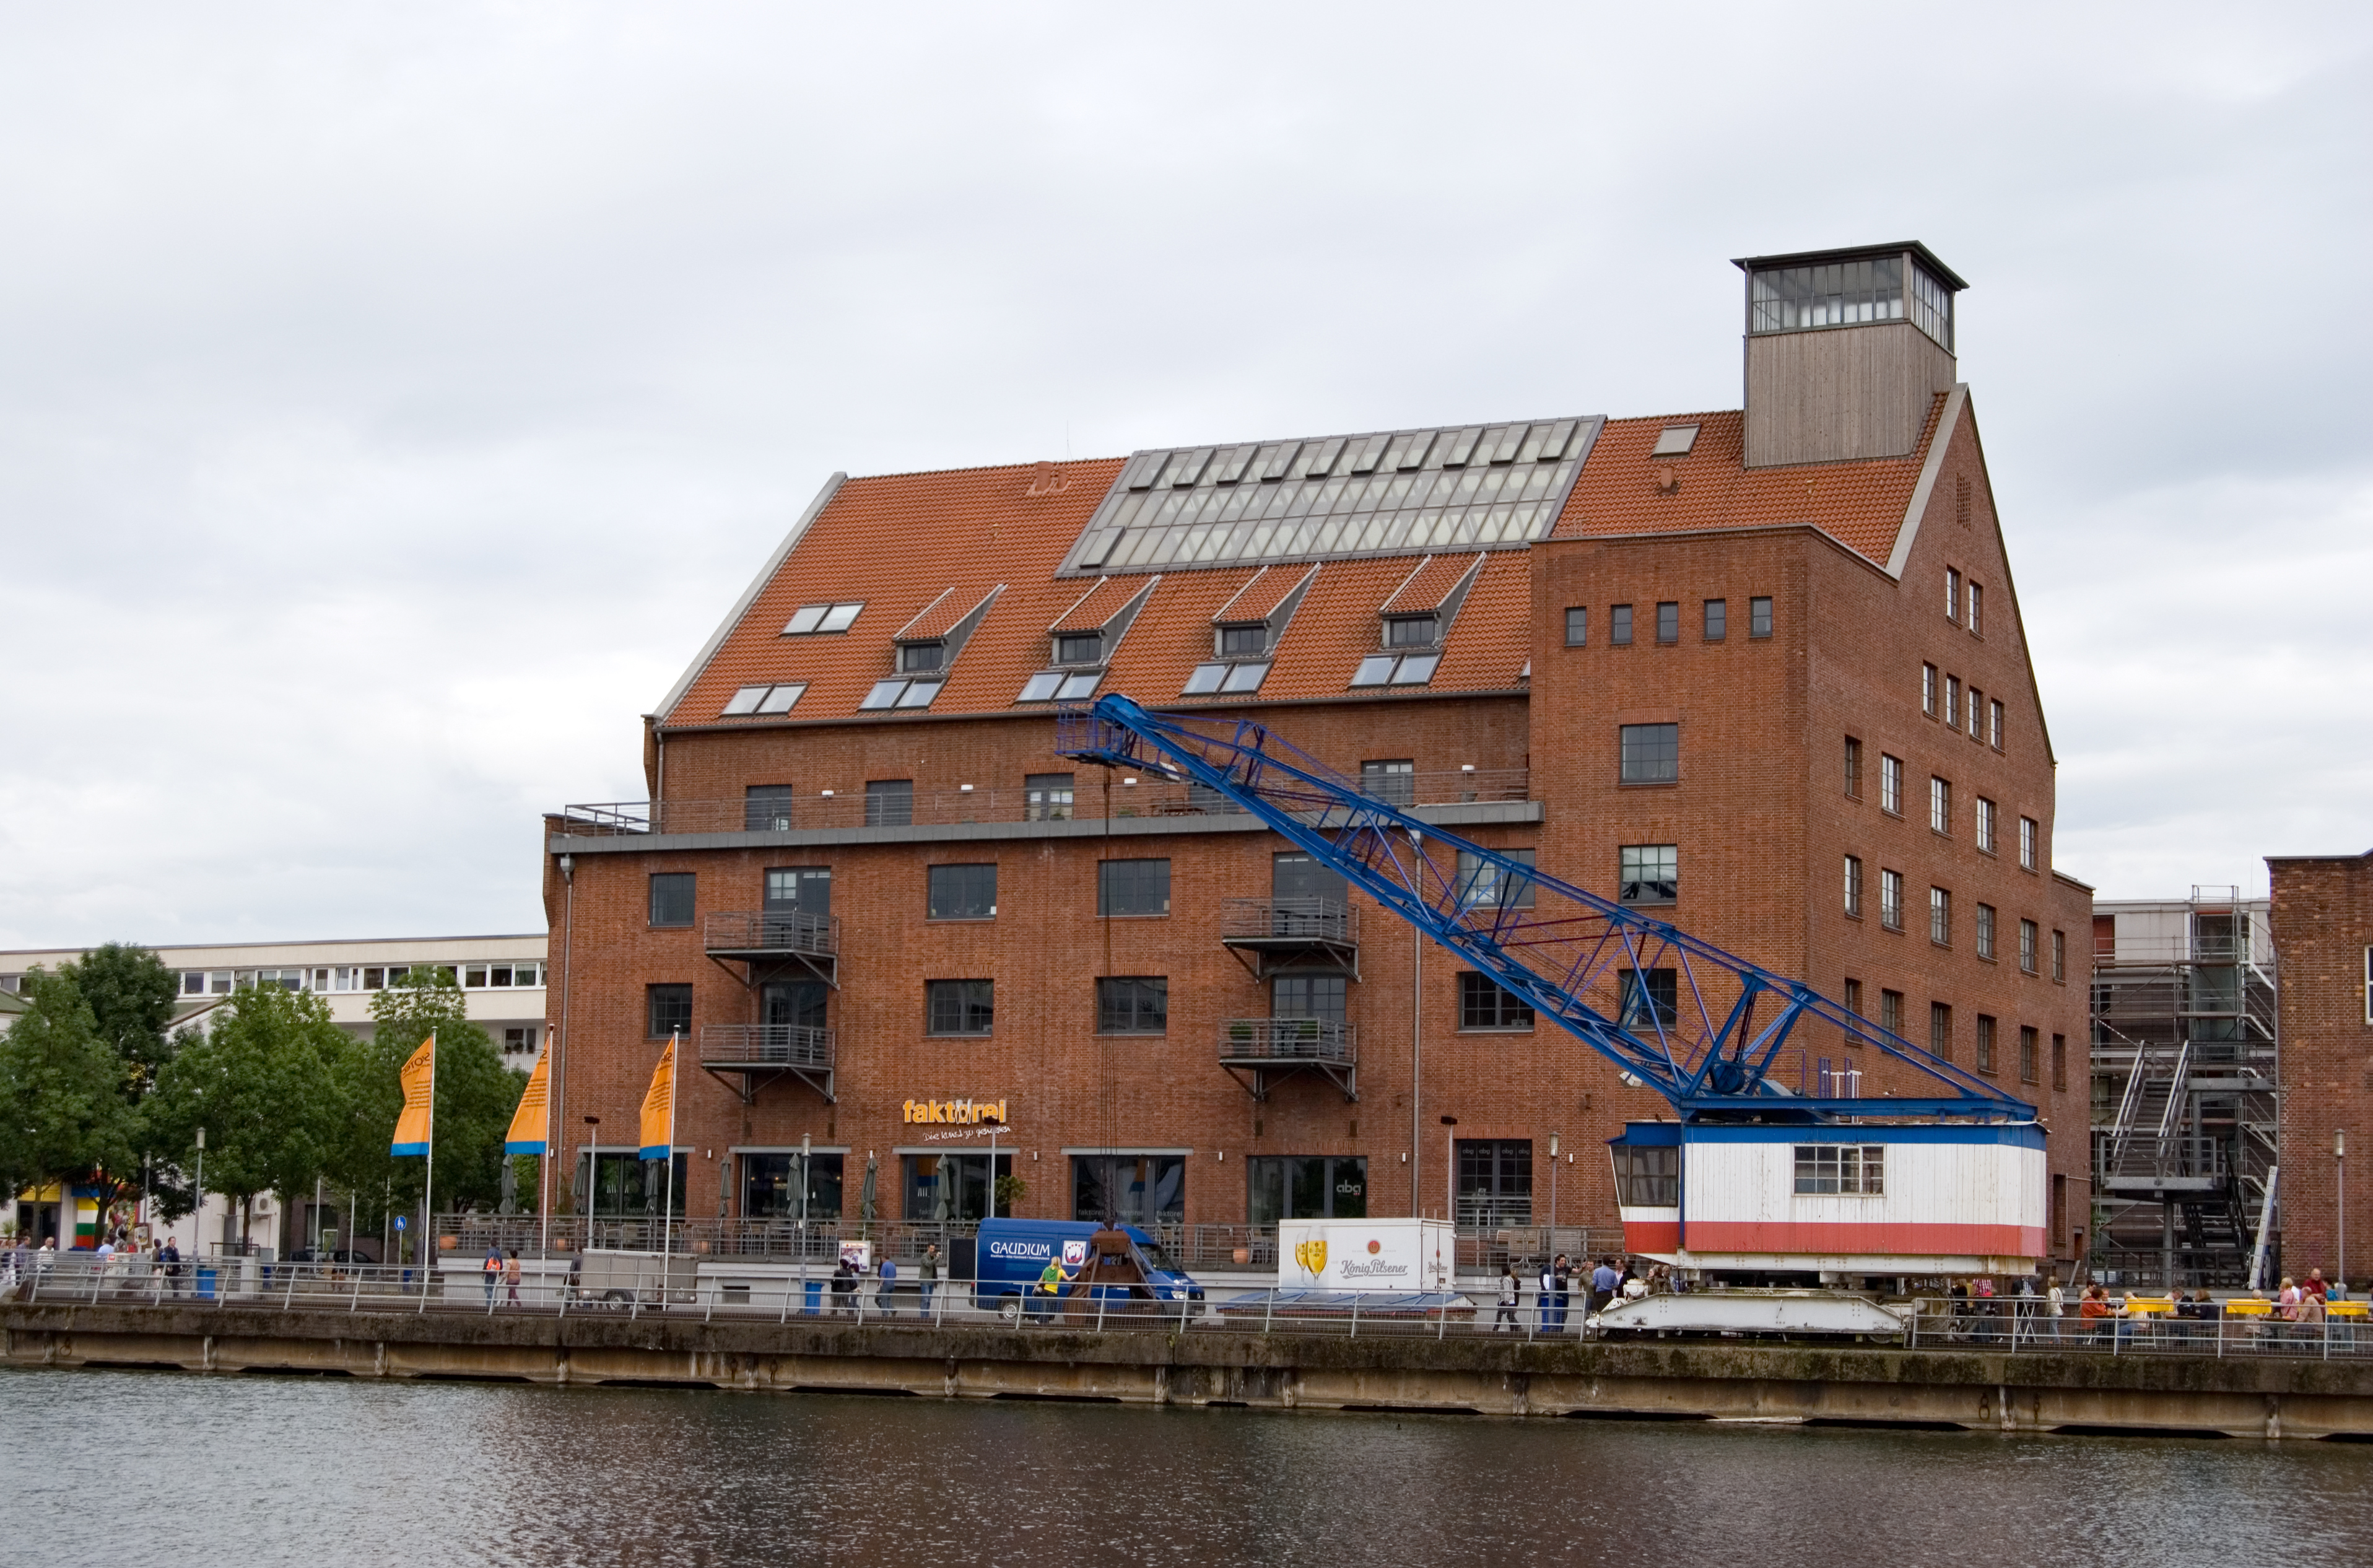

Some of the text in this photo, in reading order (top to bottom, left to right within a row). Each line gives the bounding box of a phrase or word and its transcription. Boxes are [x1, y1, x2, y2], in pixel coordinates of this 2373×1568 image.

[964, 1130, 973, 1139] zu
[991, 1242, 1050, 1257] GAUDIUM
[1340, 1260, 1370, 1276] König
